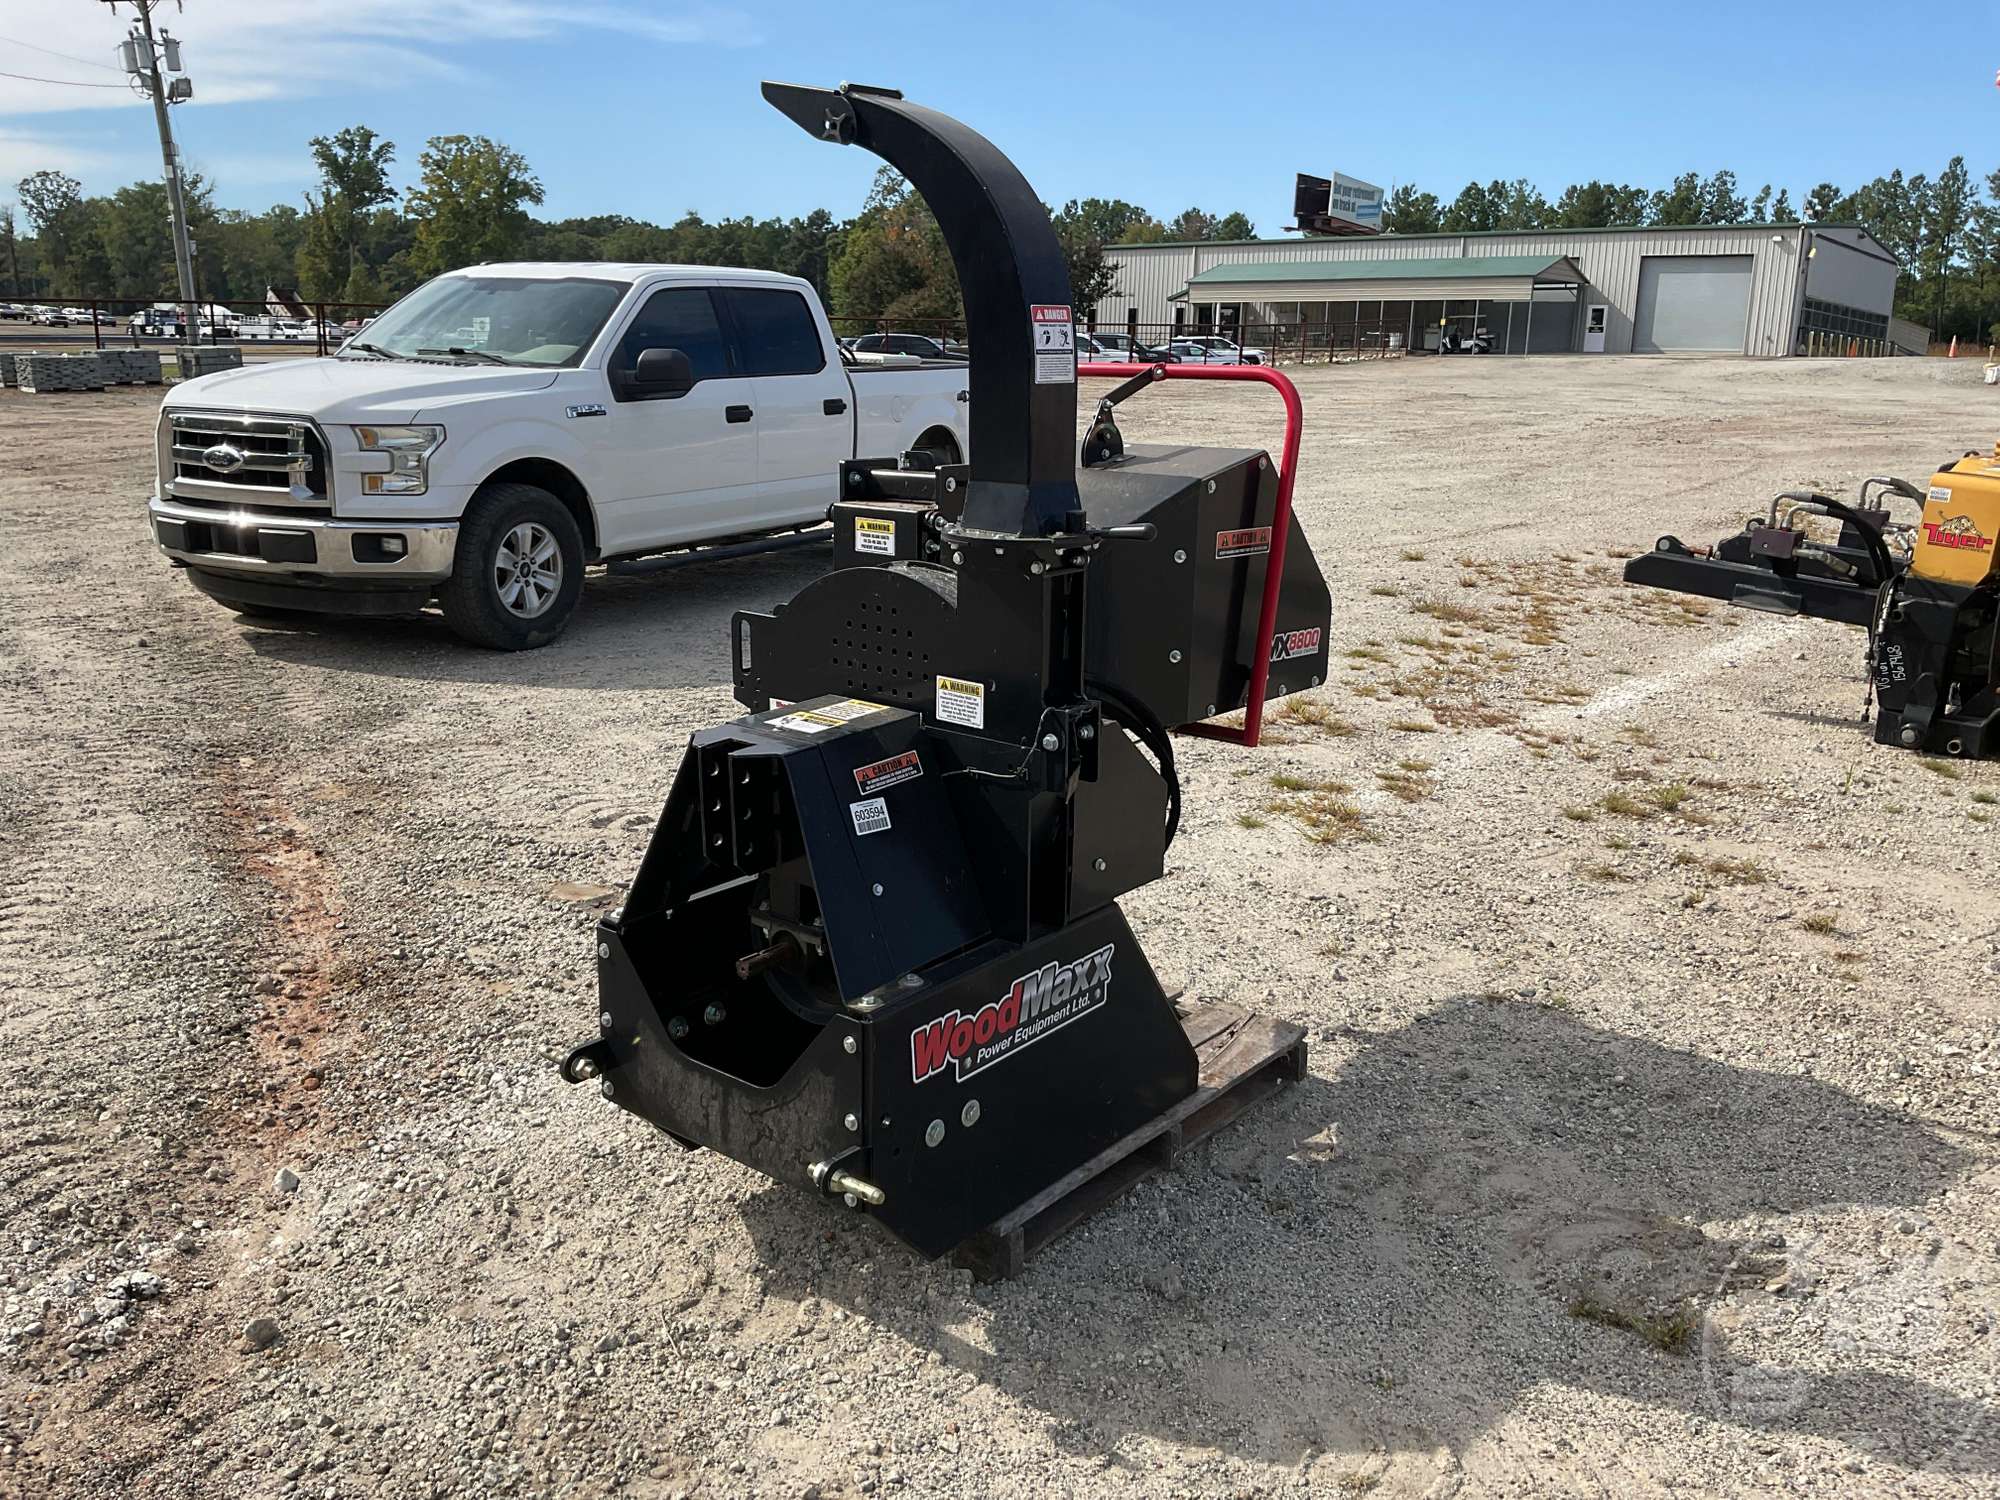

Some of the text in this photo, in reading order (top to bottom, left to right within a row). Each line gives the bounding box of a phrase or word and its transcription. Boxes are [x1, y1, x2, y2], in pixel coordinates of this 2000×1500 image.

[1044, 309, 1068, 320] DANGER
[1923, 522, 1993, 549] Tiger
[950, 680, 980, 696] WARNING
[872, 759, 903, 776] CAUTION
[855, 805, 885, 822] 603594
[914, 949, 1112, 1078] WoodMaxx
[977, 995, 1091, 1063] Power Equipment Ltd.
